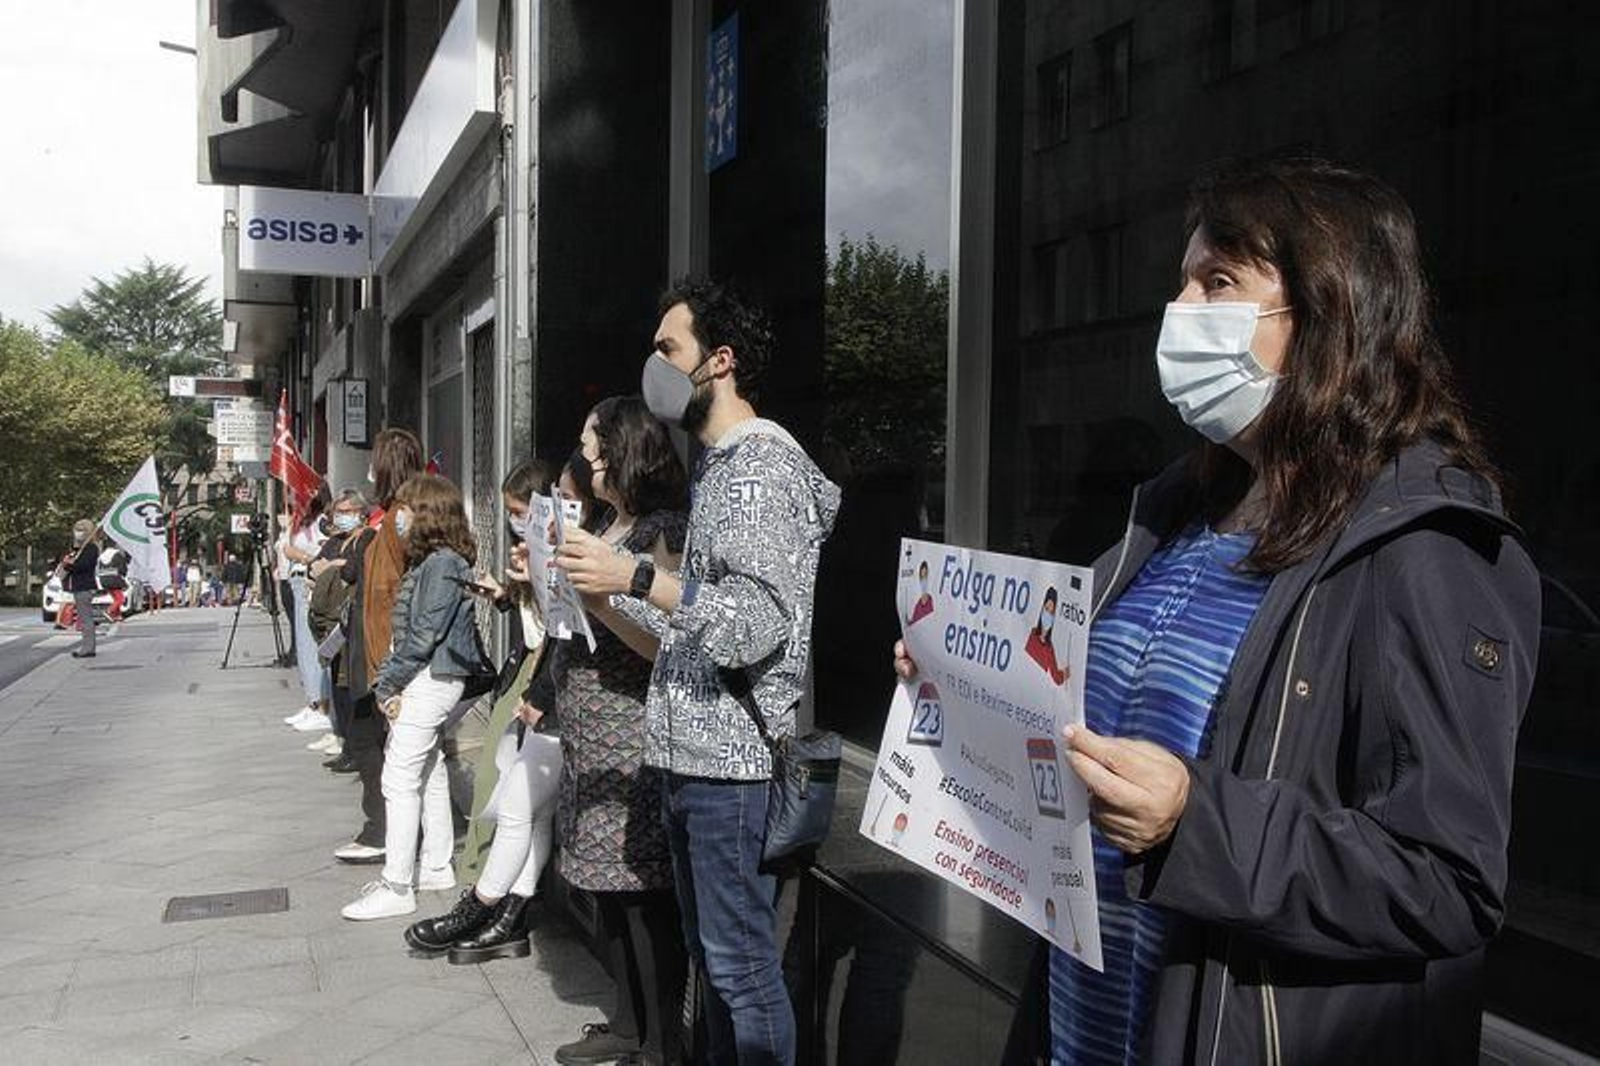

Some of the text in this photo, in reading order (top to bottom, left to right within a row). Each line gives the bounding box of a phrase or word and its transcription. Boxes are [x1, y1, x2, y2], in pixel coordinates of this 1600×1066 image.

[247, 218, 338, 245] asisa
[938, 555, 1031, 614] Folga no
[1058, 600, 1086, 626] ratio
[945, 619, 1012, 672] ensino
[912, 703, 941, 734] 23
[1015, 707, 1056, 736] especial
[889, 751, 915, 778] máis
[1035, 763, 1058, 803] 23
[878, 767, 912, 804] recursos
[934, 820, 1029, 886] Ensino presencial
[935, 851, 1022, 909] con seguridade
